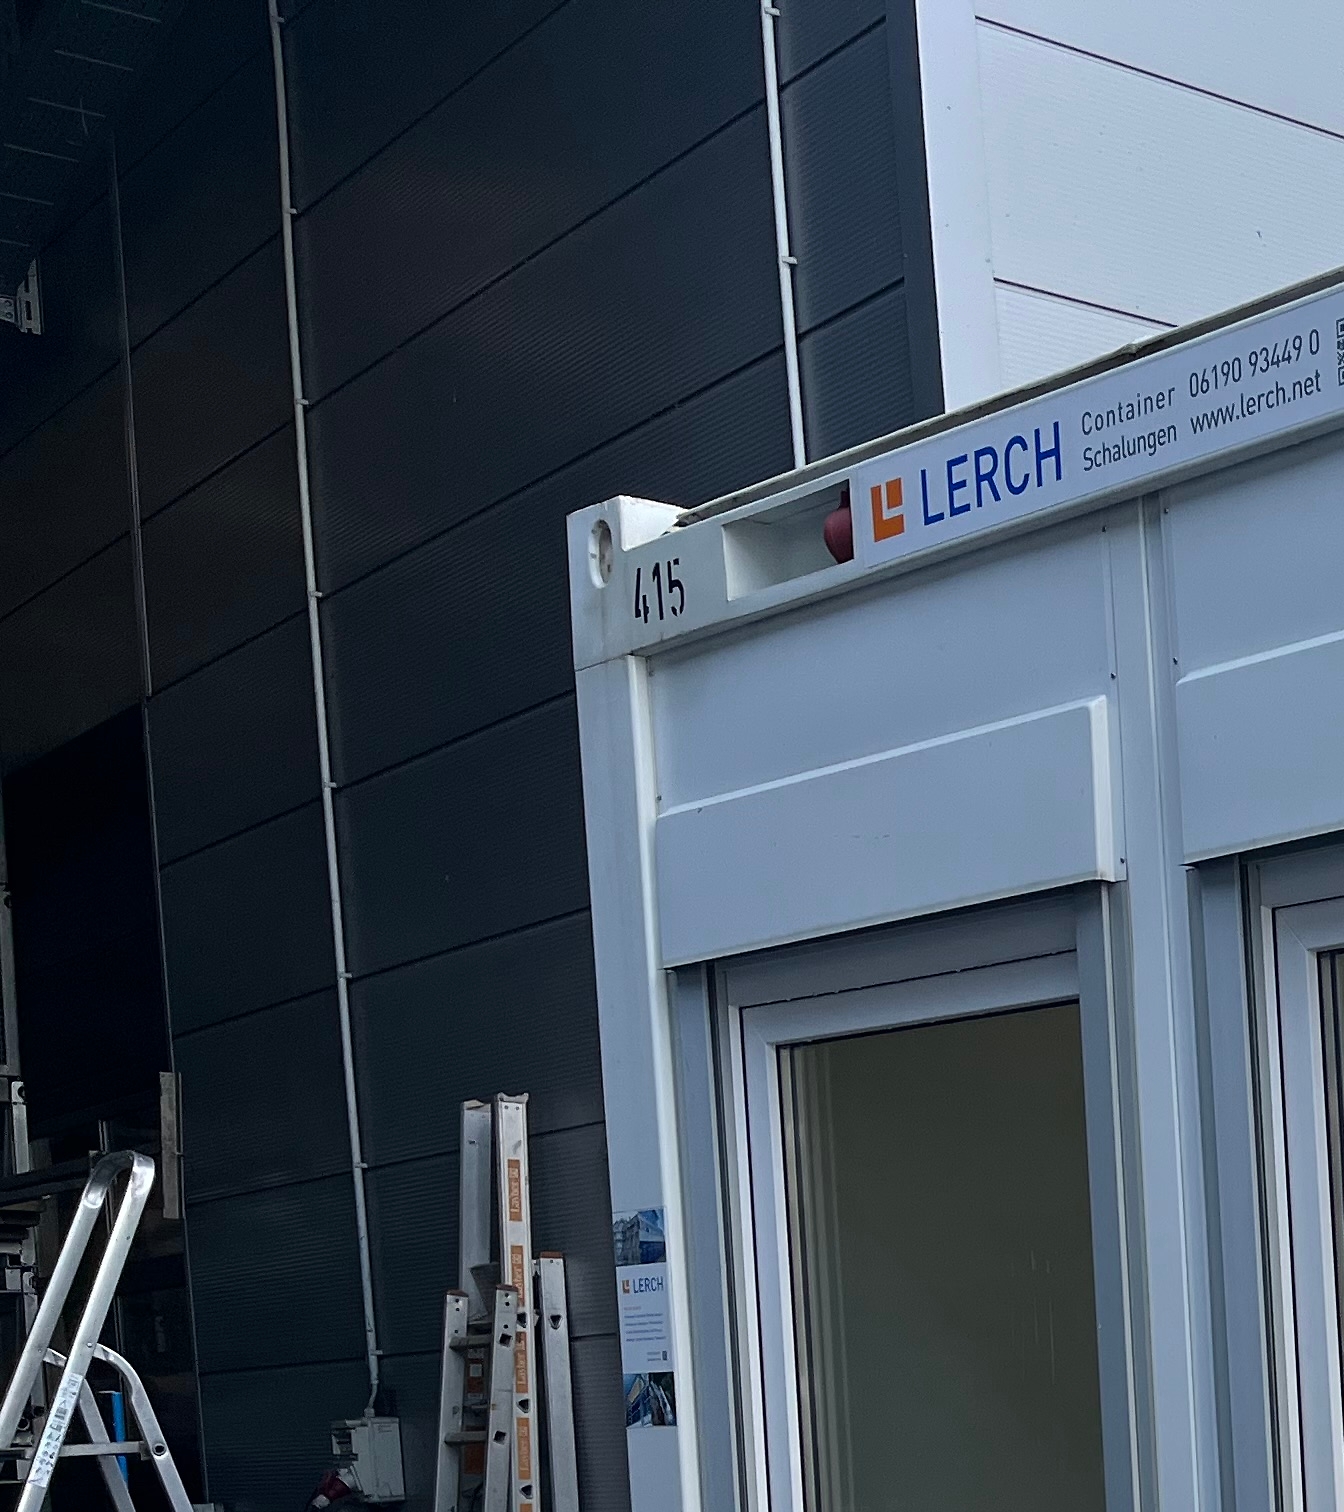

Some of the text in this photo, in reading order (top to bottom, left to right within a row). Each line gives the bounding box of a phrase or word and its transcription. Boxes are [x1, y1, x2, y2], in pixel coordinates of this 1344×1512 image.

[1081, 328, 1321, 437] Container 06190 93449 0
[1082, 369, 1322, 472] Schalungen www.lerch.net
[921, 420, 1063, 527] LERCH
[634, 558, 685, 624] 415
[632, 1276, 664, 1294] LERCH
